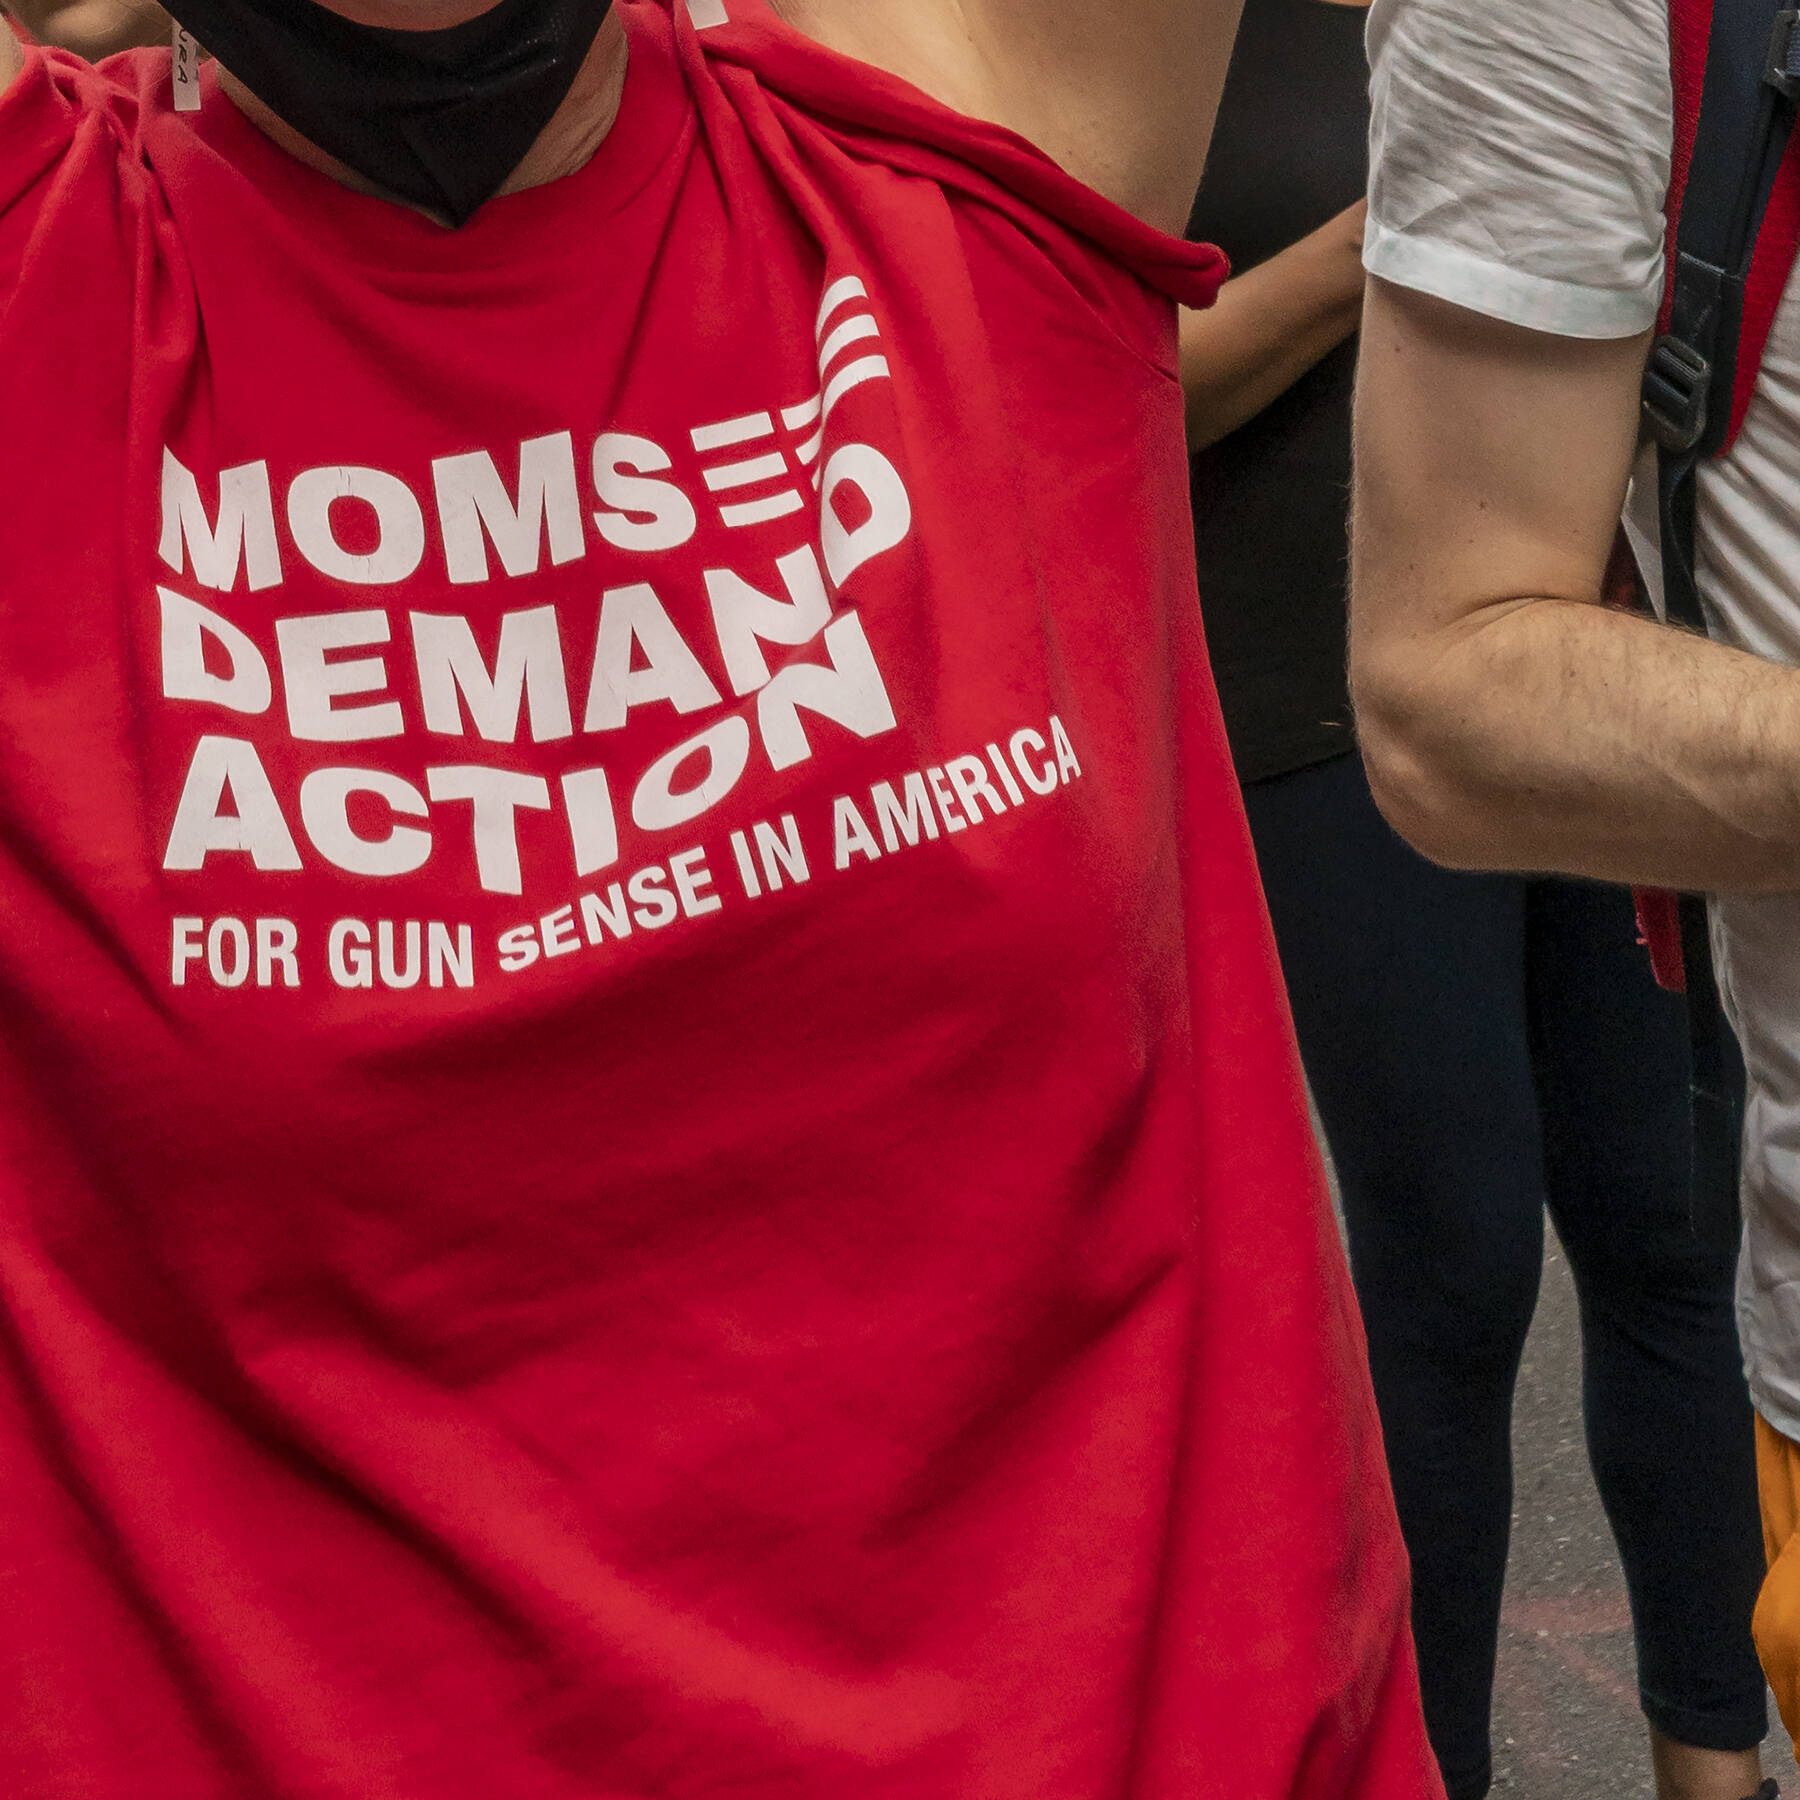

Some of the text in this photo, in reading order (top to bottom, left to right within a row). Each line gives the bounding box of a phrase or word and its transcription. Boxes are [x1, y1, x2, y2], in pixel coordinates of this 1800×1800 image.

[157, 429, 698, 594] MOMS
[157, 443, 913, 745] DEMAND
[162, 609, 898, 897] ACTION
[171, 715, 1083, 989] FOR GUN SENSE IN AMERICA
